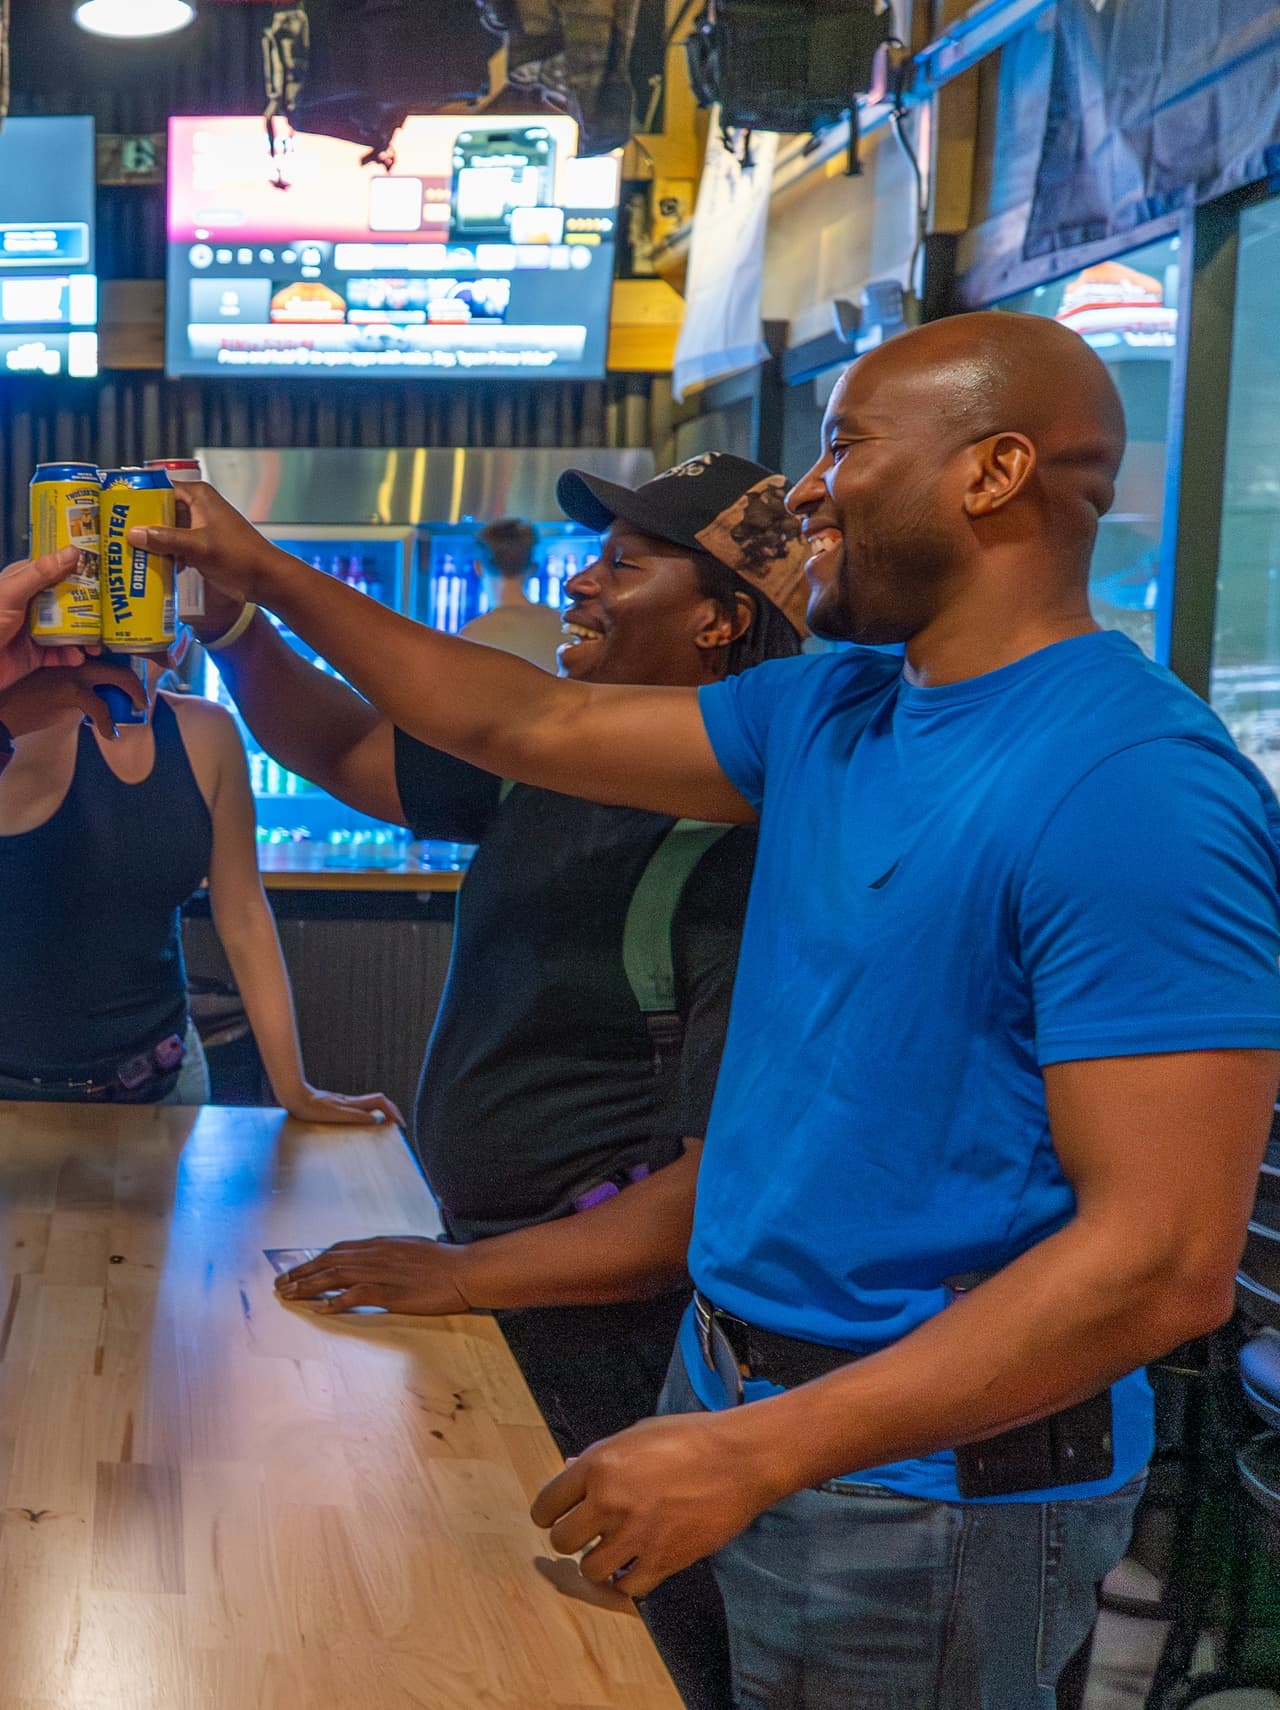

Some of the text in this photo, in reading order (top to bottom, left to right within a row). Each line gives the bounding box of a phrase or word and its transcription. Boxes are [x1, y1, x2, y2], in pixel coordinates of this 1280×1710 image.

[109, 504, 130, 537] TEA
[108, 542, 133, 624] TWISTED
[132, 549, 145, 590] ORIGIN
